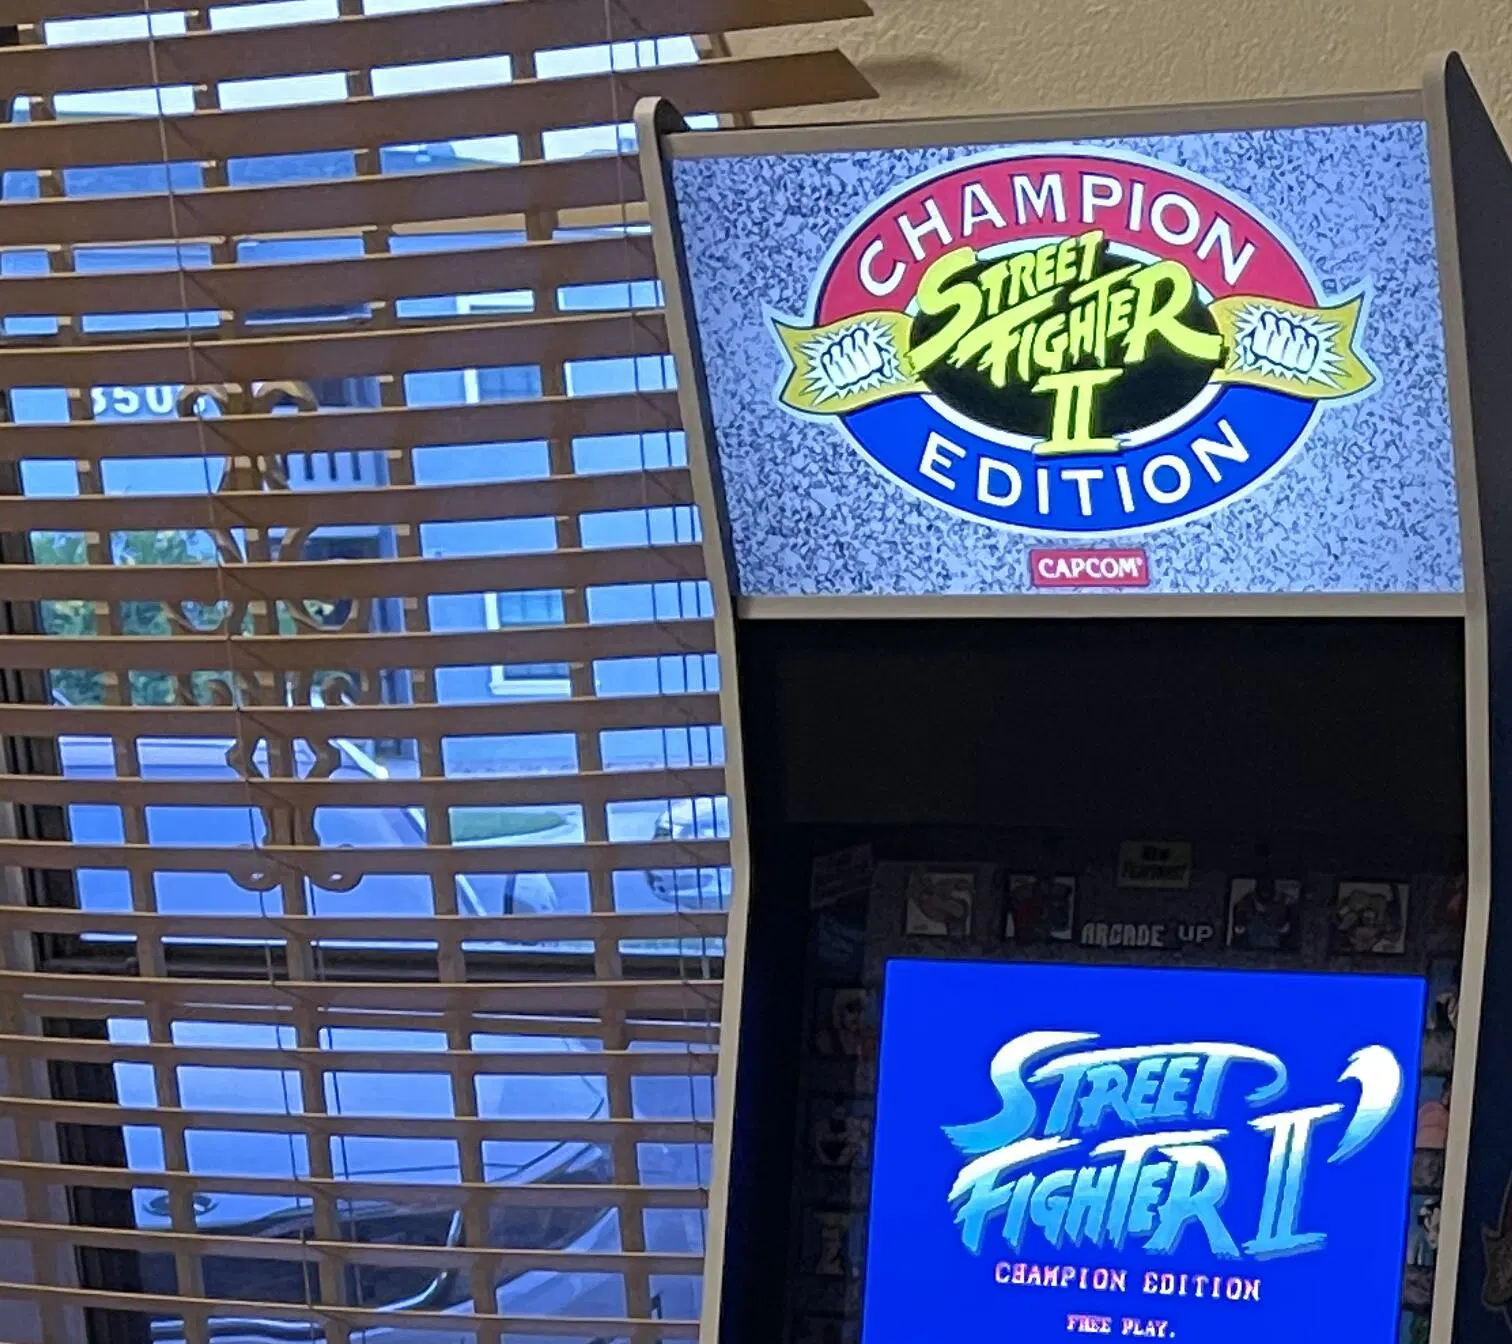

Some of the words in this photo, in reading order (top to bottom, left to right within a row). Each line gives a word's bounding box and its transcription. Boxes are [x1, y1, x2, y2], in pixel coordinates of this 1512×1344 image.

[858, 173, 1258, 296] CHAMPION
[907, 229, 1108, 375] STREET
[965, 257, 1230, 388] FIGHTER
[1032, 367, 1125, 454] II
[918, 416, 1250, 517] EDITION
[1038, 553, 1142, 582] CAPCOM
[940, 1030, 1287, 1150] STREET
[948, 1127, 1243, 1258] FIGHTER
[995, 1261, 1127, 1292] CHAMPION
[1143, 1271, 1261, 1301] EDITION
[1066, 1313, 1112, 1333] FREE
[1121, 1317, 1176, 1338] PLAY.
